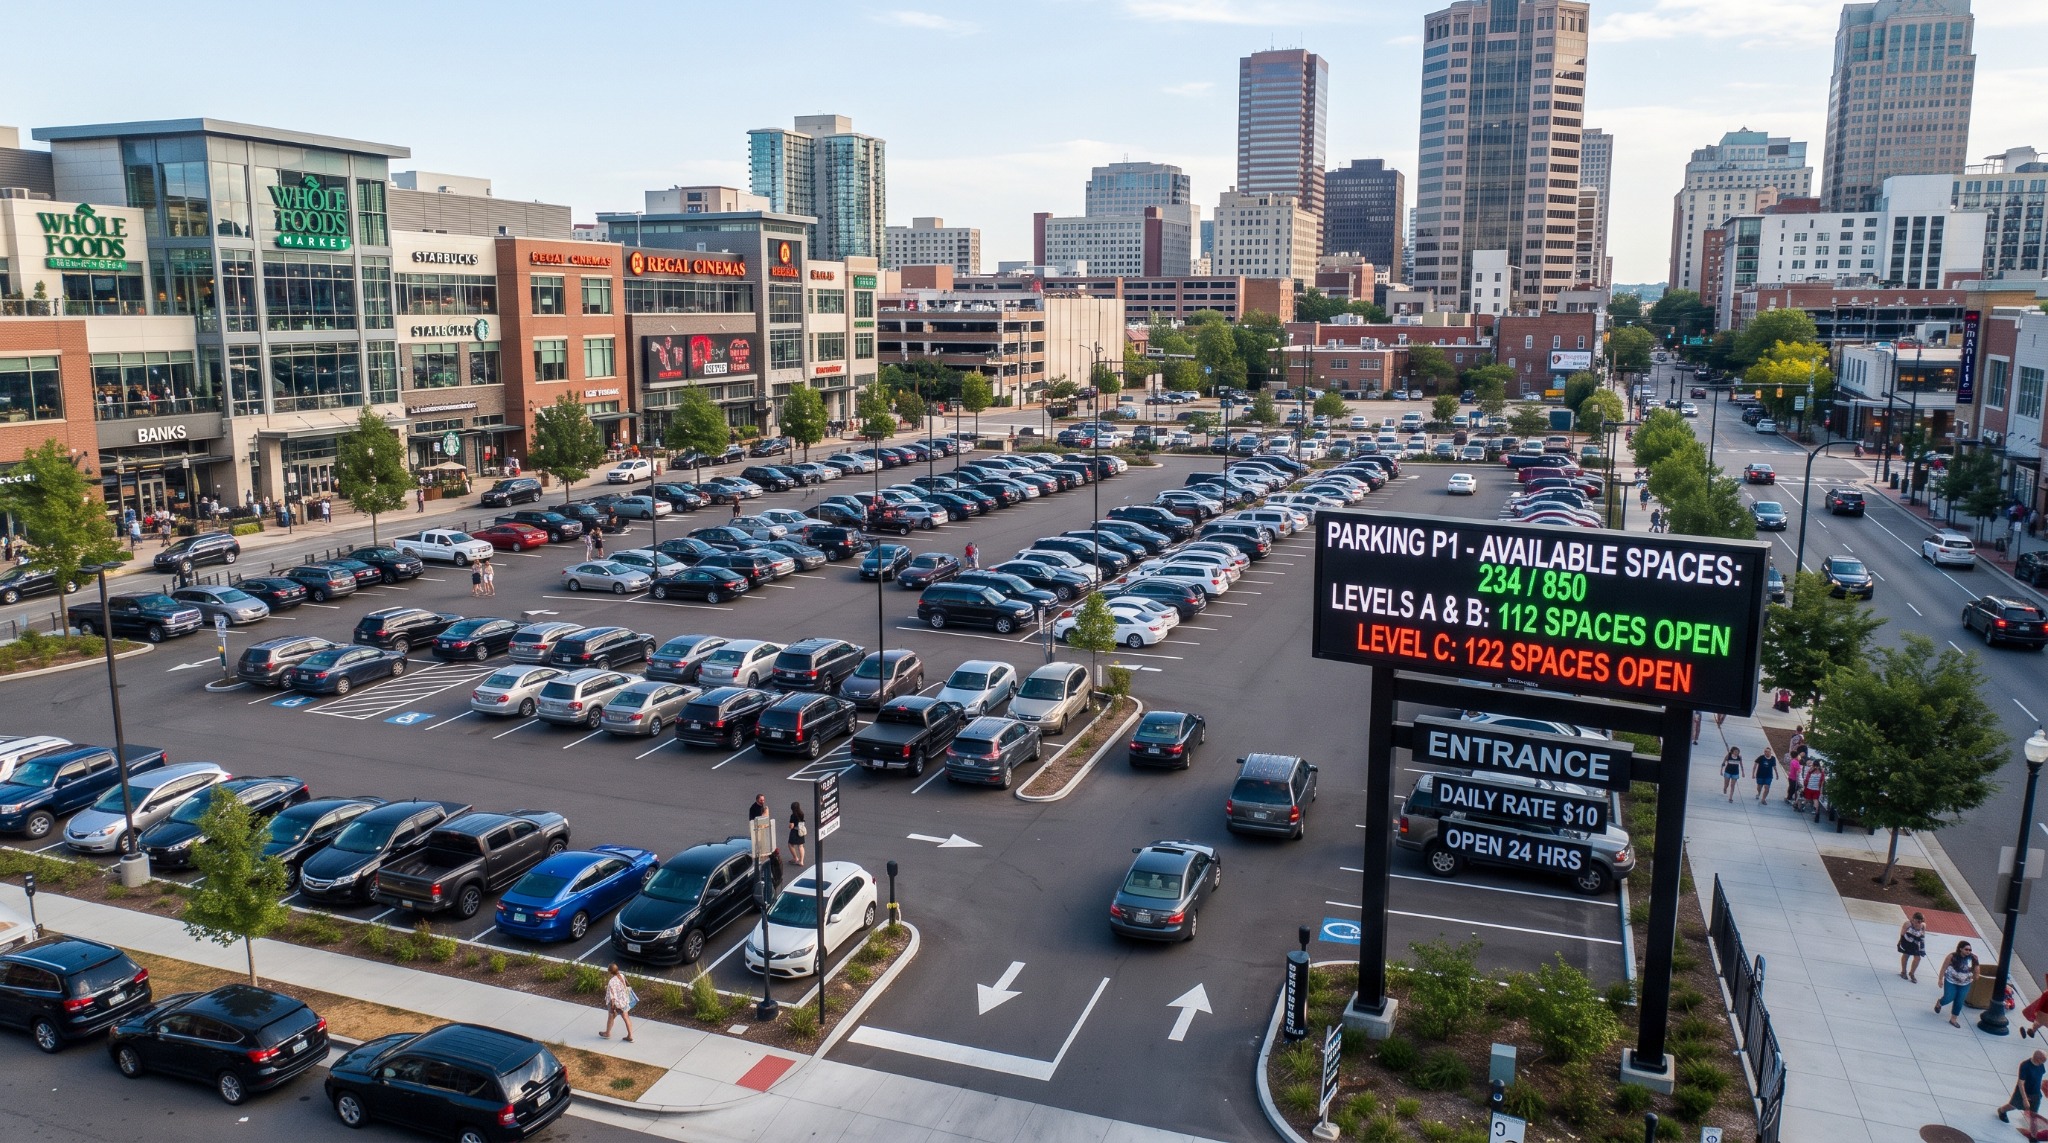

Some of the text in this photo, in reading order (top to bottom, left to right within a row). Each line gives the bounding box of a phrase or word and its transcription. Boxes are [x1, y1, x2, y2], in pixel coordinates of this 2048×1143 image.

[272, 187, 347, 212] WHOLE
[36, 212, 128, 238] WHOLE
[279, 209, 348, 235] FOODS
[43, 234, 126, 259] FOODS
[283, 236, 348, 248] MARKET
[415, 251, 479, 265] STARBUCKS
[647, 256, 746, 276] REGAL CINEMAS
[137, 425, 187, 443] BANKS
[1327, 521, 1425, 556] PARKING
[1432, 530, 1458, 560] P1
[1479, 534, 1618, 576] AVAILABLE
[1624, 547, 1742, 587] SPACES:
[1477, 563, 1587, 602] 234 / 850
[1331, 582, 1731, 657] LEVELS A & B: 112 SPACES OPEN
[1357, 622, 1692, 693] LEVEL C: 122 SPACES OPEN
[1428, 731, 1611, 781] ENTRANCE
[1440, 783, 1598, 827] DAILY RATE $10
[1446, 829, 1582, 870] OPEN 24 HRS
